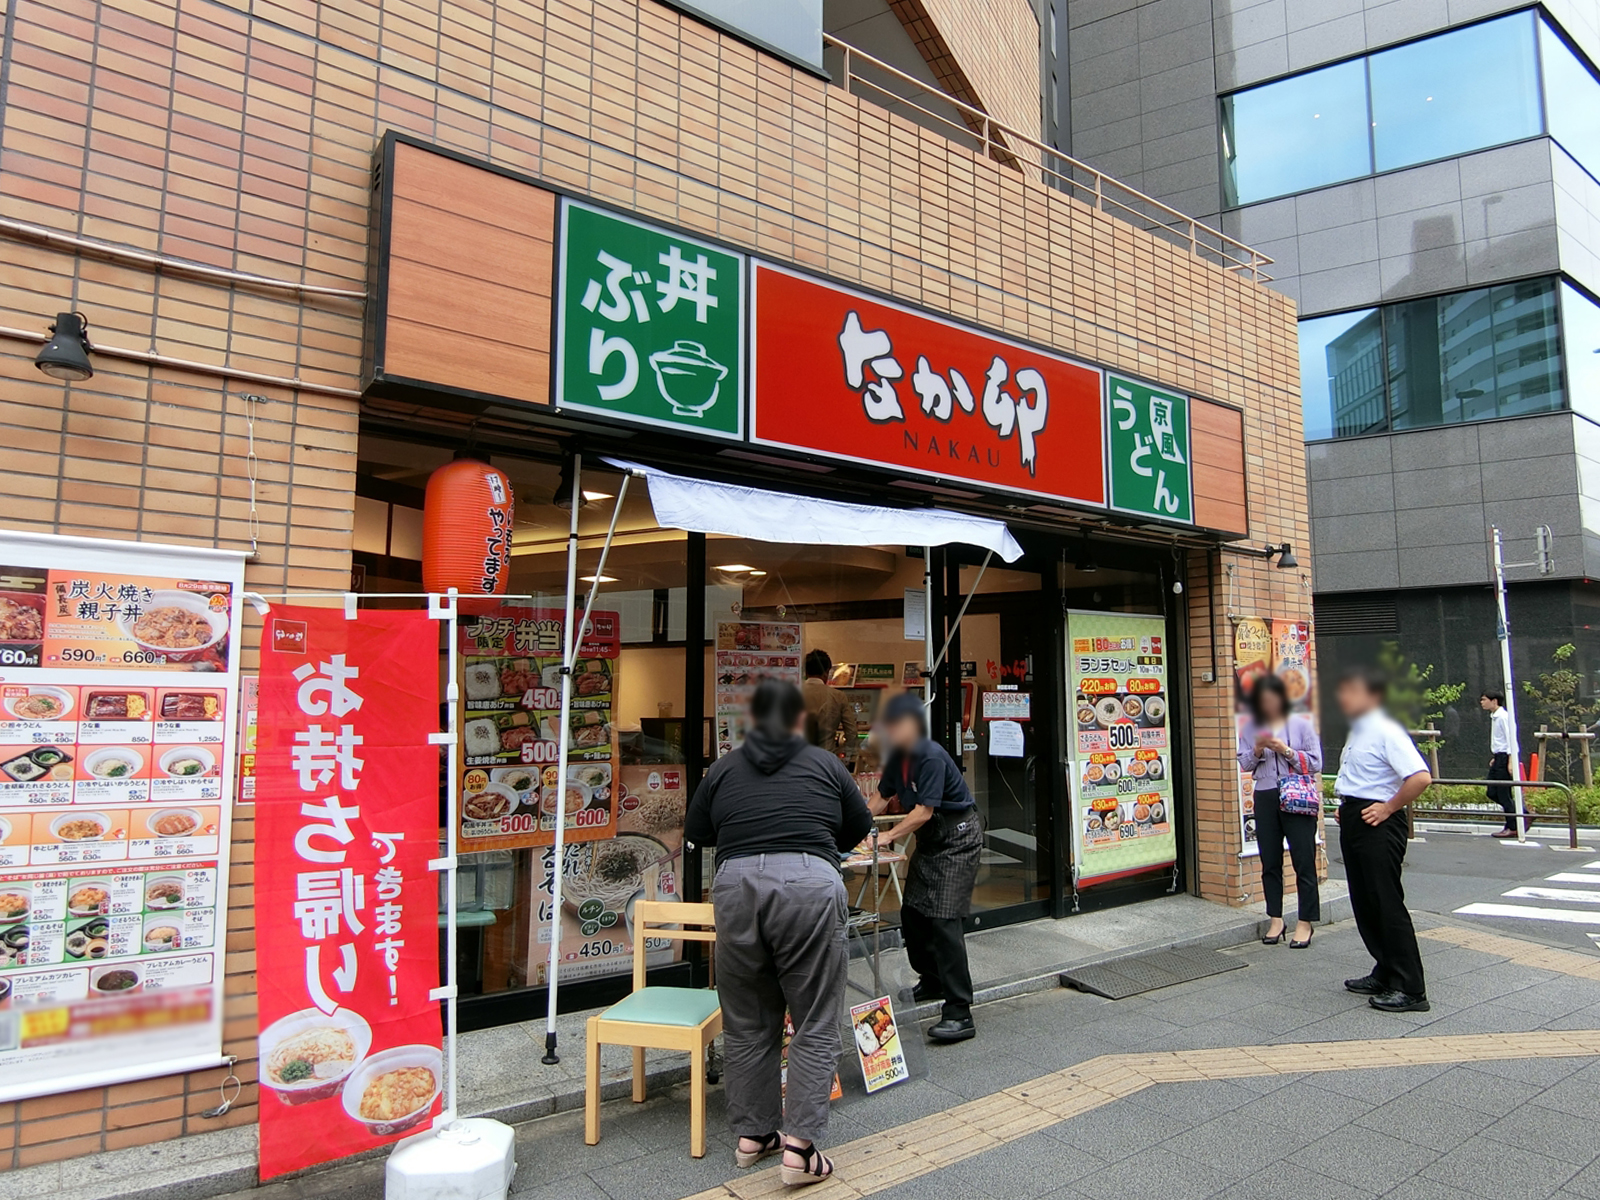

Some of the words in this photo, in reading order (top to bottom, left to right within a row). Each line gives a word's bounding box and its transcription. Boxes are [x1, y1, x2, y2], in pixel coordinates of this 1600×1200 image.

[656, 245, 719, 324] 丼
[580, 249, 653, 401] ぶり
[838, 310, 1049, 478] なか卯
[1153, 401, 1176, 458] 京風
[903, 429, 1001, 468] NAKAU
[1112, 385, 1180, 514] うどん
[482, 507, 505, 595] やってます
[69, 580, 153, 603] 炭火焼き
[78, 601, 144, 622] 親子丼
[477, 637, 504, 649] 限定
[515, 620, 561, 651] 弁当
[0, 649, 33, 665] 60円
[61, 648, 102, 662] 590円
[123, 651, 162, 664] 660円
[1080, 657, 1136, 673] ランチセット
[522, 689, 561, 708] 450円
[467, 774, 487, 784] 80円
[581, 905, 602, 914] ルチン
[580, 940, 619, 958] 450円
